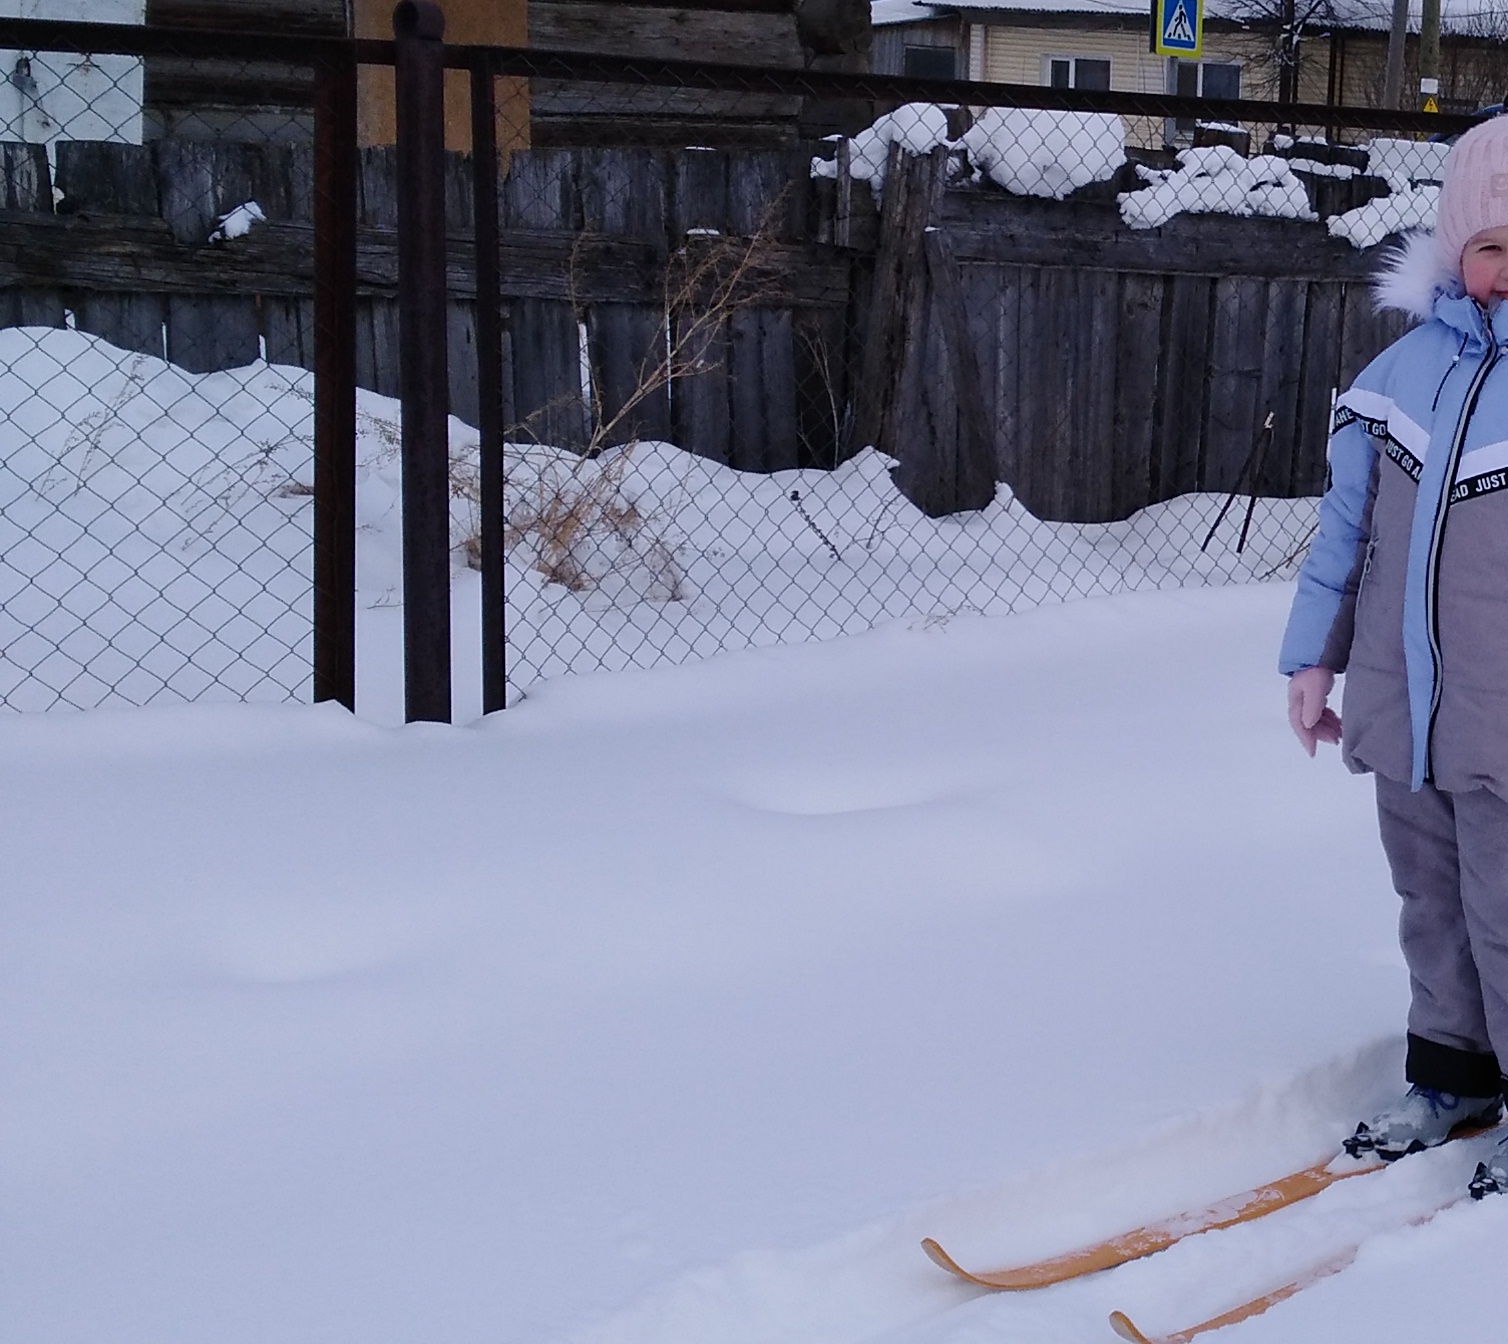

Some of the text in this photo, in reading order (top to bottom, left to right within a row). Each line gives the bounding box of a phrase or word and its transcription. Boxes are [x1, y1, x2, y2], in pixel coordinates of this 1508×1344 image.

[1371, 422, 1387, 436] GO
[1401, 454, 1414, 471] GO
[1475, 472, 1506, 493] JUST
